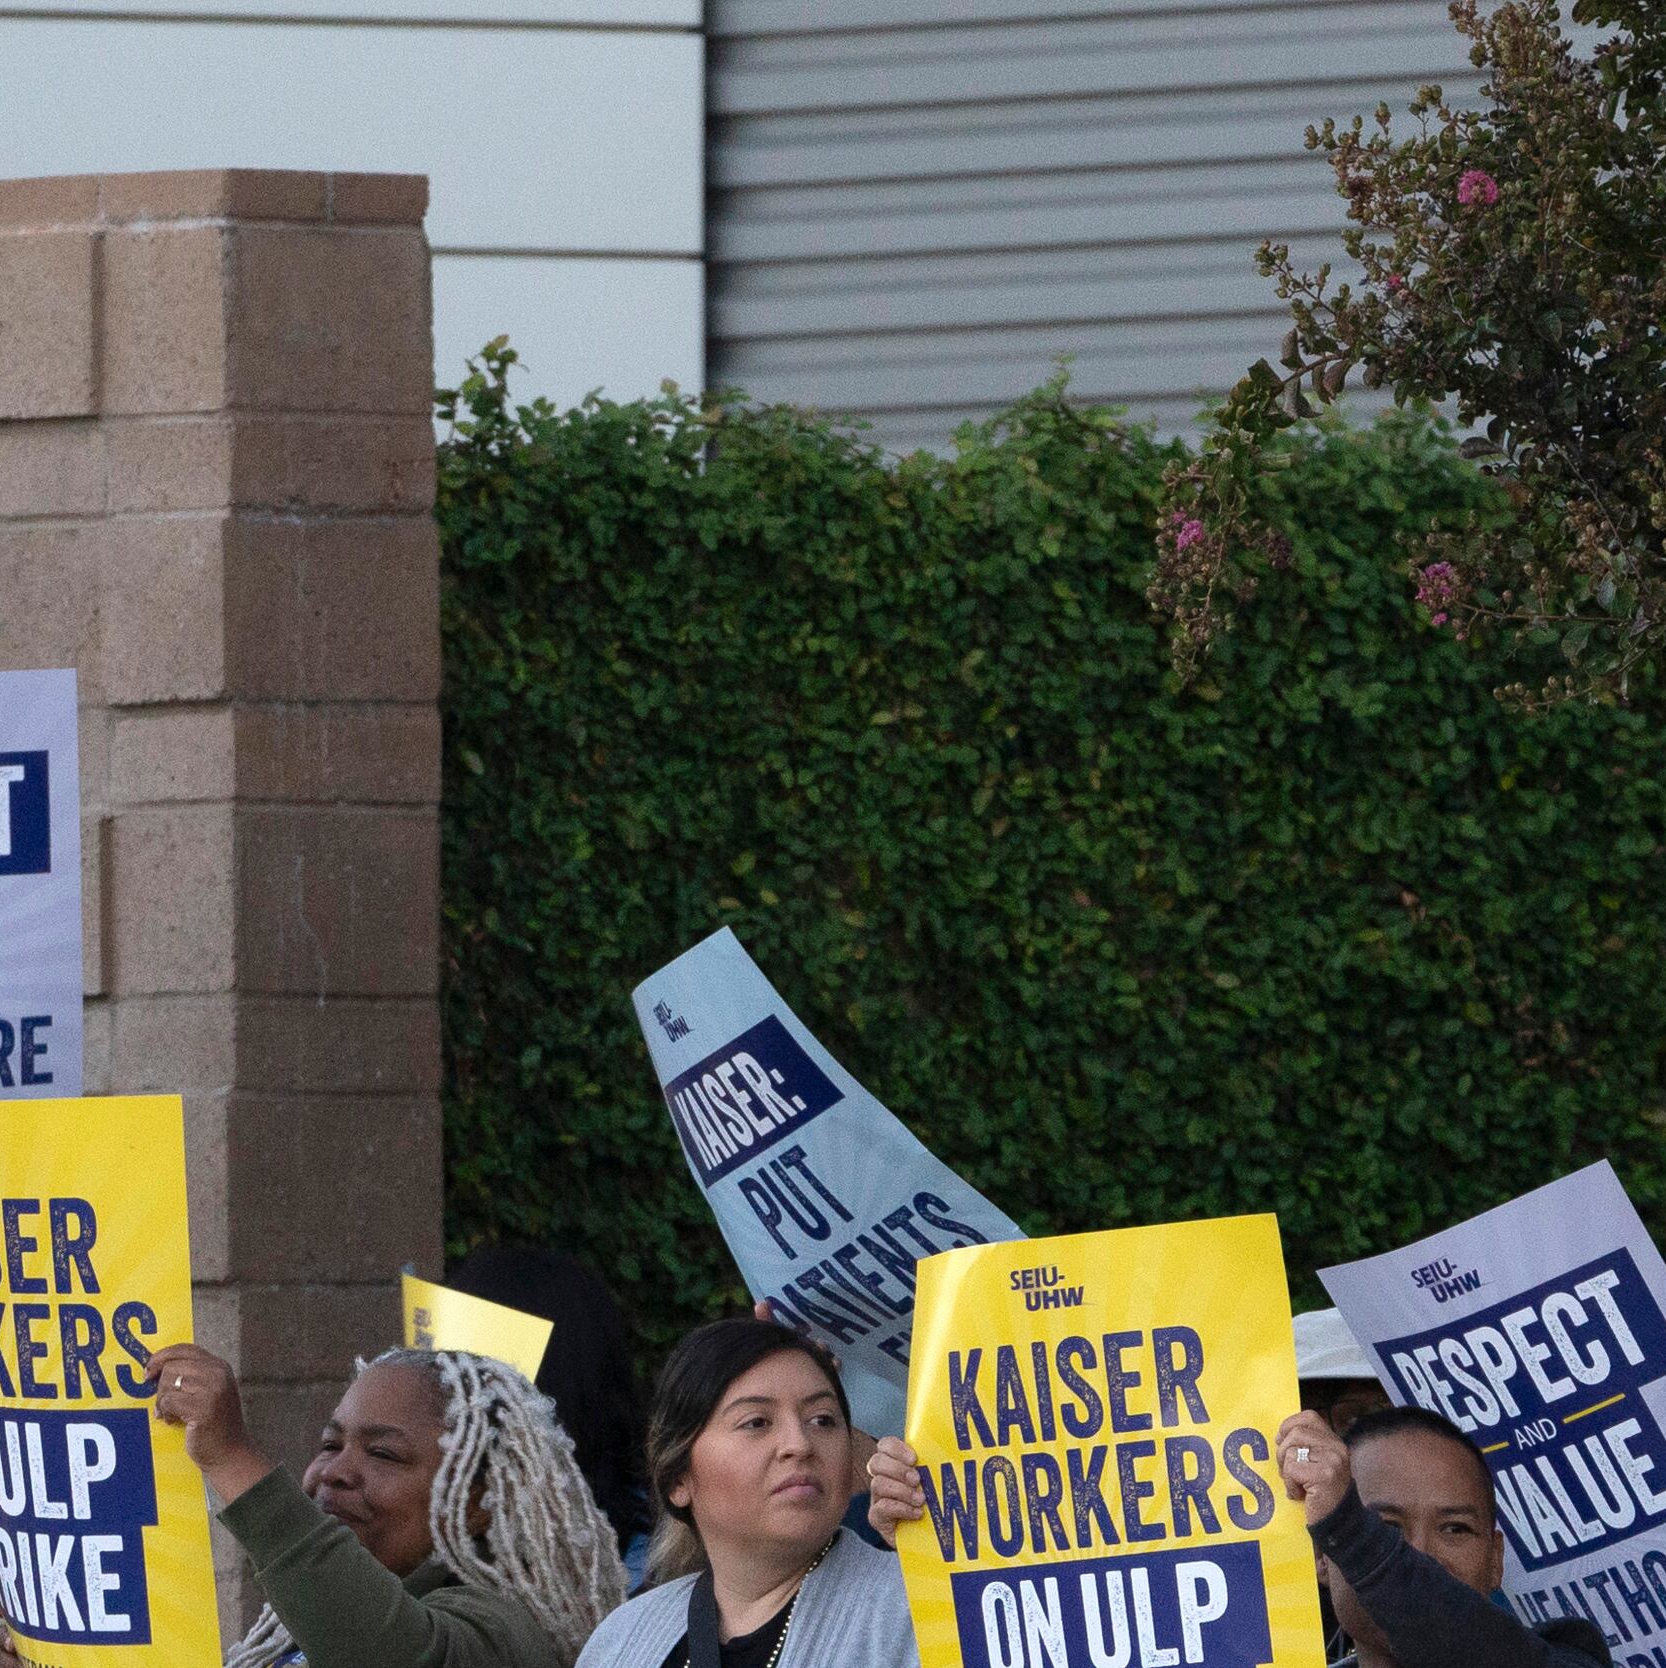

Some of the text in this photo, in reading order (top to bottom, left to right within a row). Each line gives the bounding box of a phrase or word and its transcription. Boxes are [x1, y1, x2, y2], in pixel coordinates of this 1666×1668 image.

[674, 1051, 808, 1171] KAISER:
[738, 1145, 854, 1261] PUT
[1010, 1266, 1065, 1290] SEIU-
[1025, 1286, 1084, 1311] UHW
[1411, 1258, 1458, 1289] SEIU-
[1430, 1269, 1482, 1303] UHW
[948, 1326, 1210, 1451] KAISER
[1391, 1270, 1646, 1433] RESPECT
[1515, 1417, 1557, 1451] AND
[919, 1427, 1275, 1563] WORKERS
